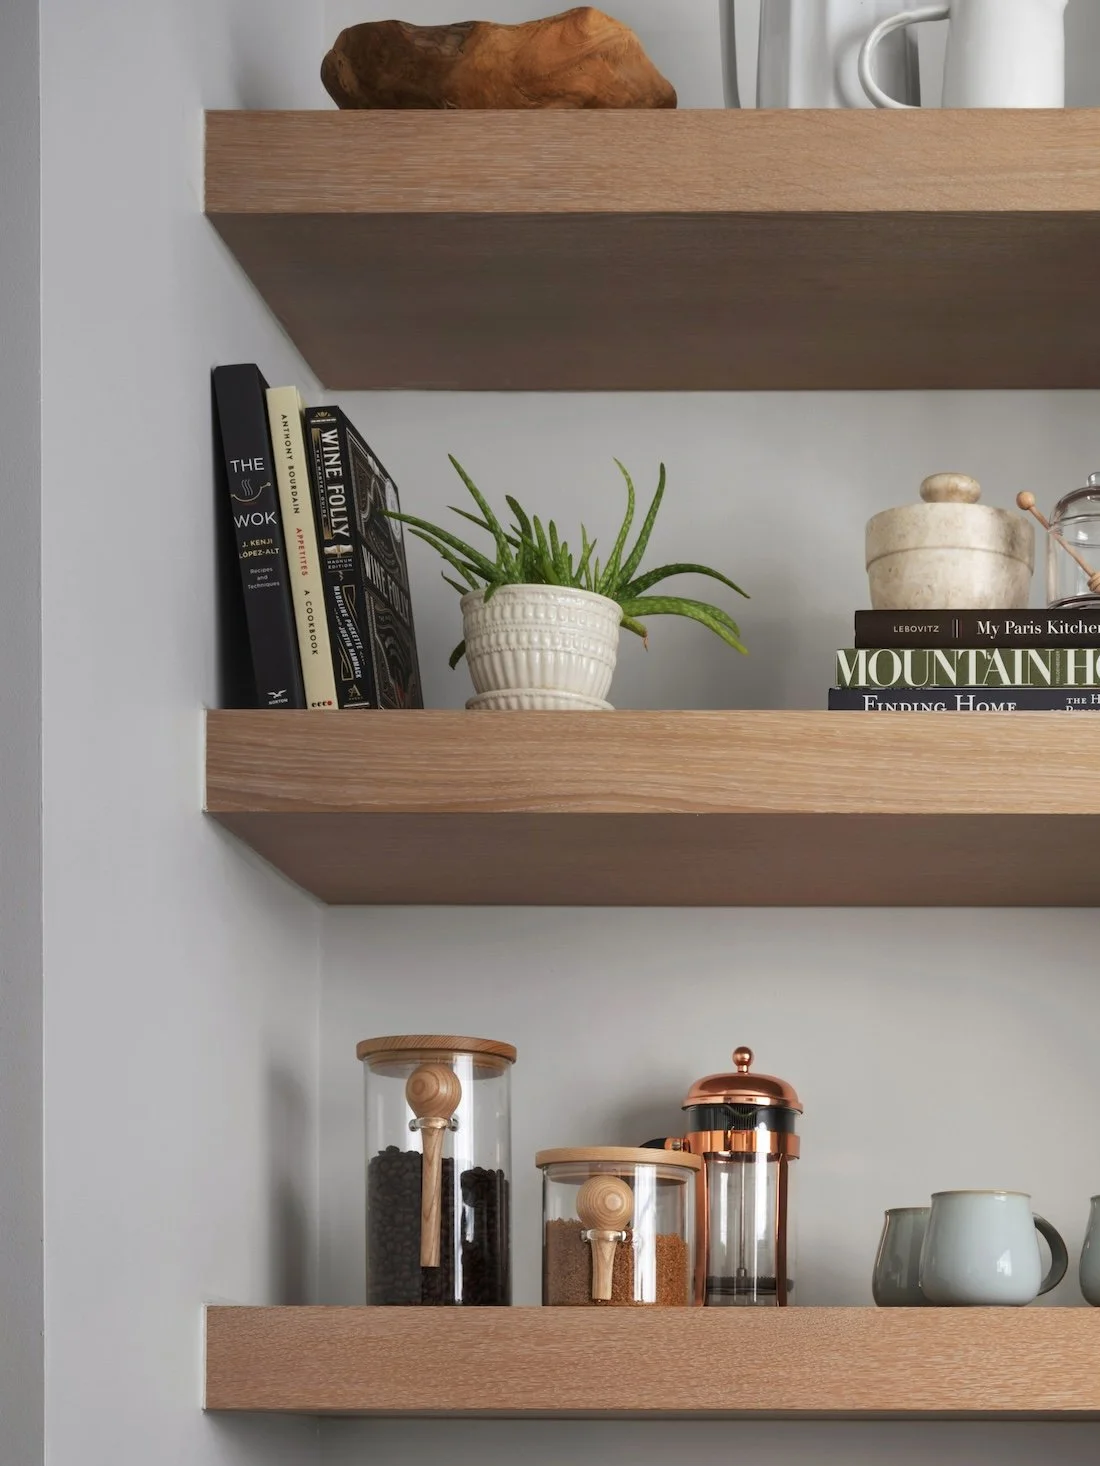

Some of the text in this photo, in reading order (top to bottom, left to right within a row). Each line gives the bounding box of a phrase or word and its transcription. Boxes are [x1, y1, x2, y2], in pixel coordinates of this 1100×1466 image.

[230, 457, 265, 473] THE
[280, 414, 300, 514] ANTHONY BOURDAIN
[321, 428, 351, 538] WINE FOLLY
[233, 511, 277, 529] WOK
[250, 538, 273, 547] KENJI
[296, 527, 309, 577] APPETITES
[250, 567, 273, 575] Recipes
[247, 581, 280, 590] Techniques
[333, 585, 364, 650] MADELINE PUCKETTE
[305, 600, 319, 656] COOKBOOK
[893, 625, 940, 633] LEBOVITZ
[976, 620, 1000, 639] My
[1004, 619, 1042, 635] Paris
[339, 626, 354, 647] JUSTIN
[348, 648, 362, 679] HAMMACK
[836, 648, 1053, 687] MOUNTAIN
[1066, 697, 1087, 705] THE
